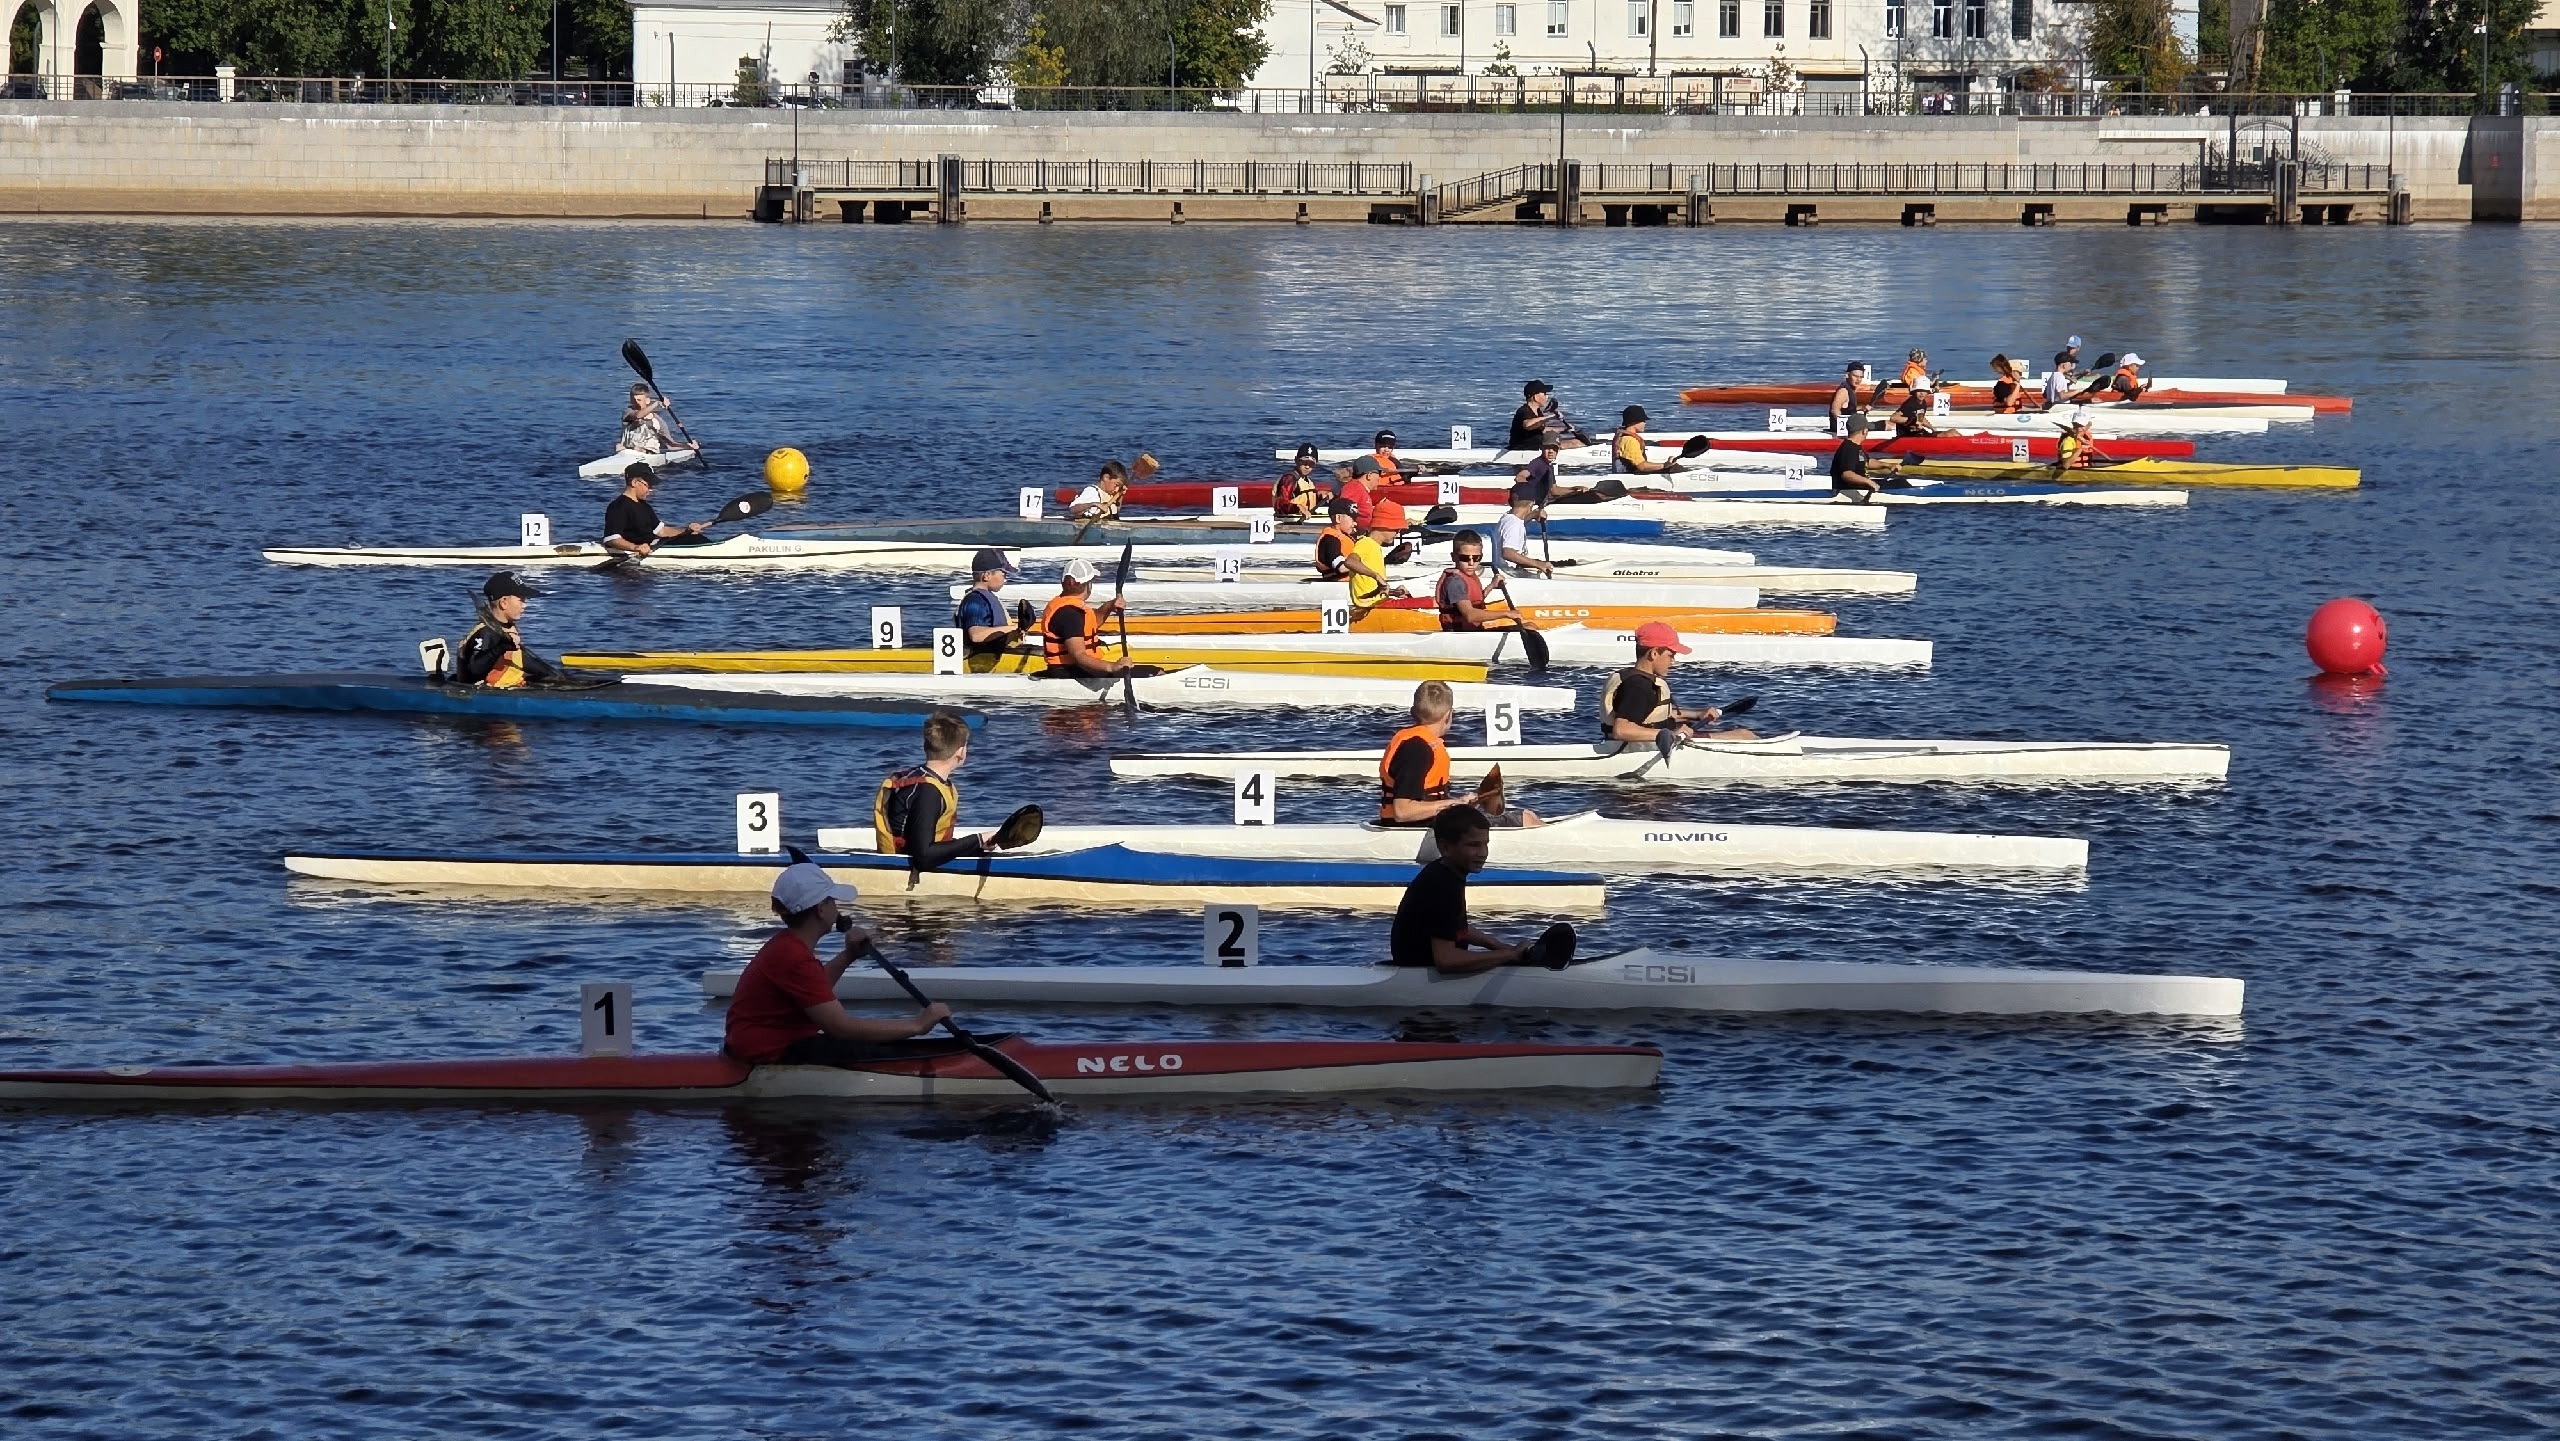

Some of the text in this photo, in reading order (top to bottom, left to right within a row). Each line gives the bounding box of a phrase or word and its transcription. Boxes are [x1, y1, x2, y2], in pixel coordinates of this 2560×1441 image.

[1771, 413, 1784, 425] 26
[1453, 430, 1466, 442] 24
[2014, 445, 2027, 457] 25
[1687, 473, 1719, 481] ECSI
[1788, 468, 1803, 480] 23
[1442, 482, 1458, 494] 20
[1025, 494, 1041, 508] 17
[1221, 494, 1237, 507] 19
[525, 522, 541, 537] 12
[1254, 520, 1271, 533] 16
[748, 545, 792, 553] PAKULIN
[1221, 558, 1239, 573] 13
[1323, 608, 1348, 627] 10
[1534, 609, 1590, 617] NELO
[880, 621, 894, 643] 9
[941, 634, 956, 657] 8
[424, 643, 445, 673] 7
[1179, 677, 1230, 689] ECSI
[1494, 703, 1513, 731] 5
[1242, 774, 1264, 806] 4
[748, 801, 768, 831] 3
[1644, 832, 1728, 842] NOWING
[1218, 911, 1245, 957] 2
[1620, 964, 1696, 984] ECSI
[594, 992, 614, 1035] 1
[1077, 1054, 1182, 1072] NELO
